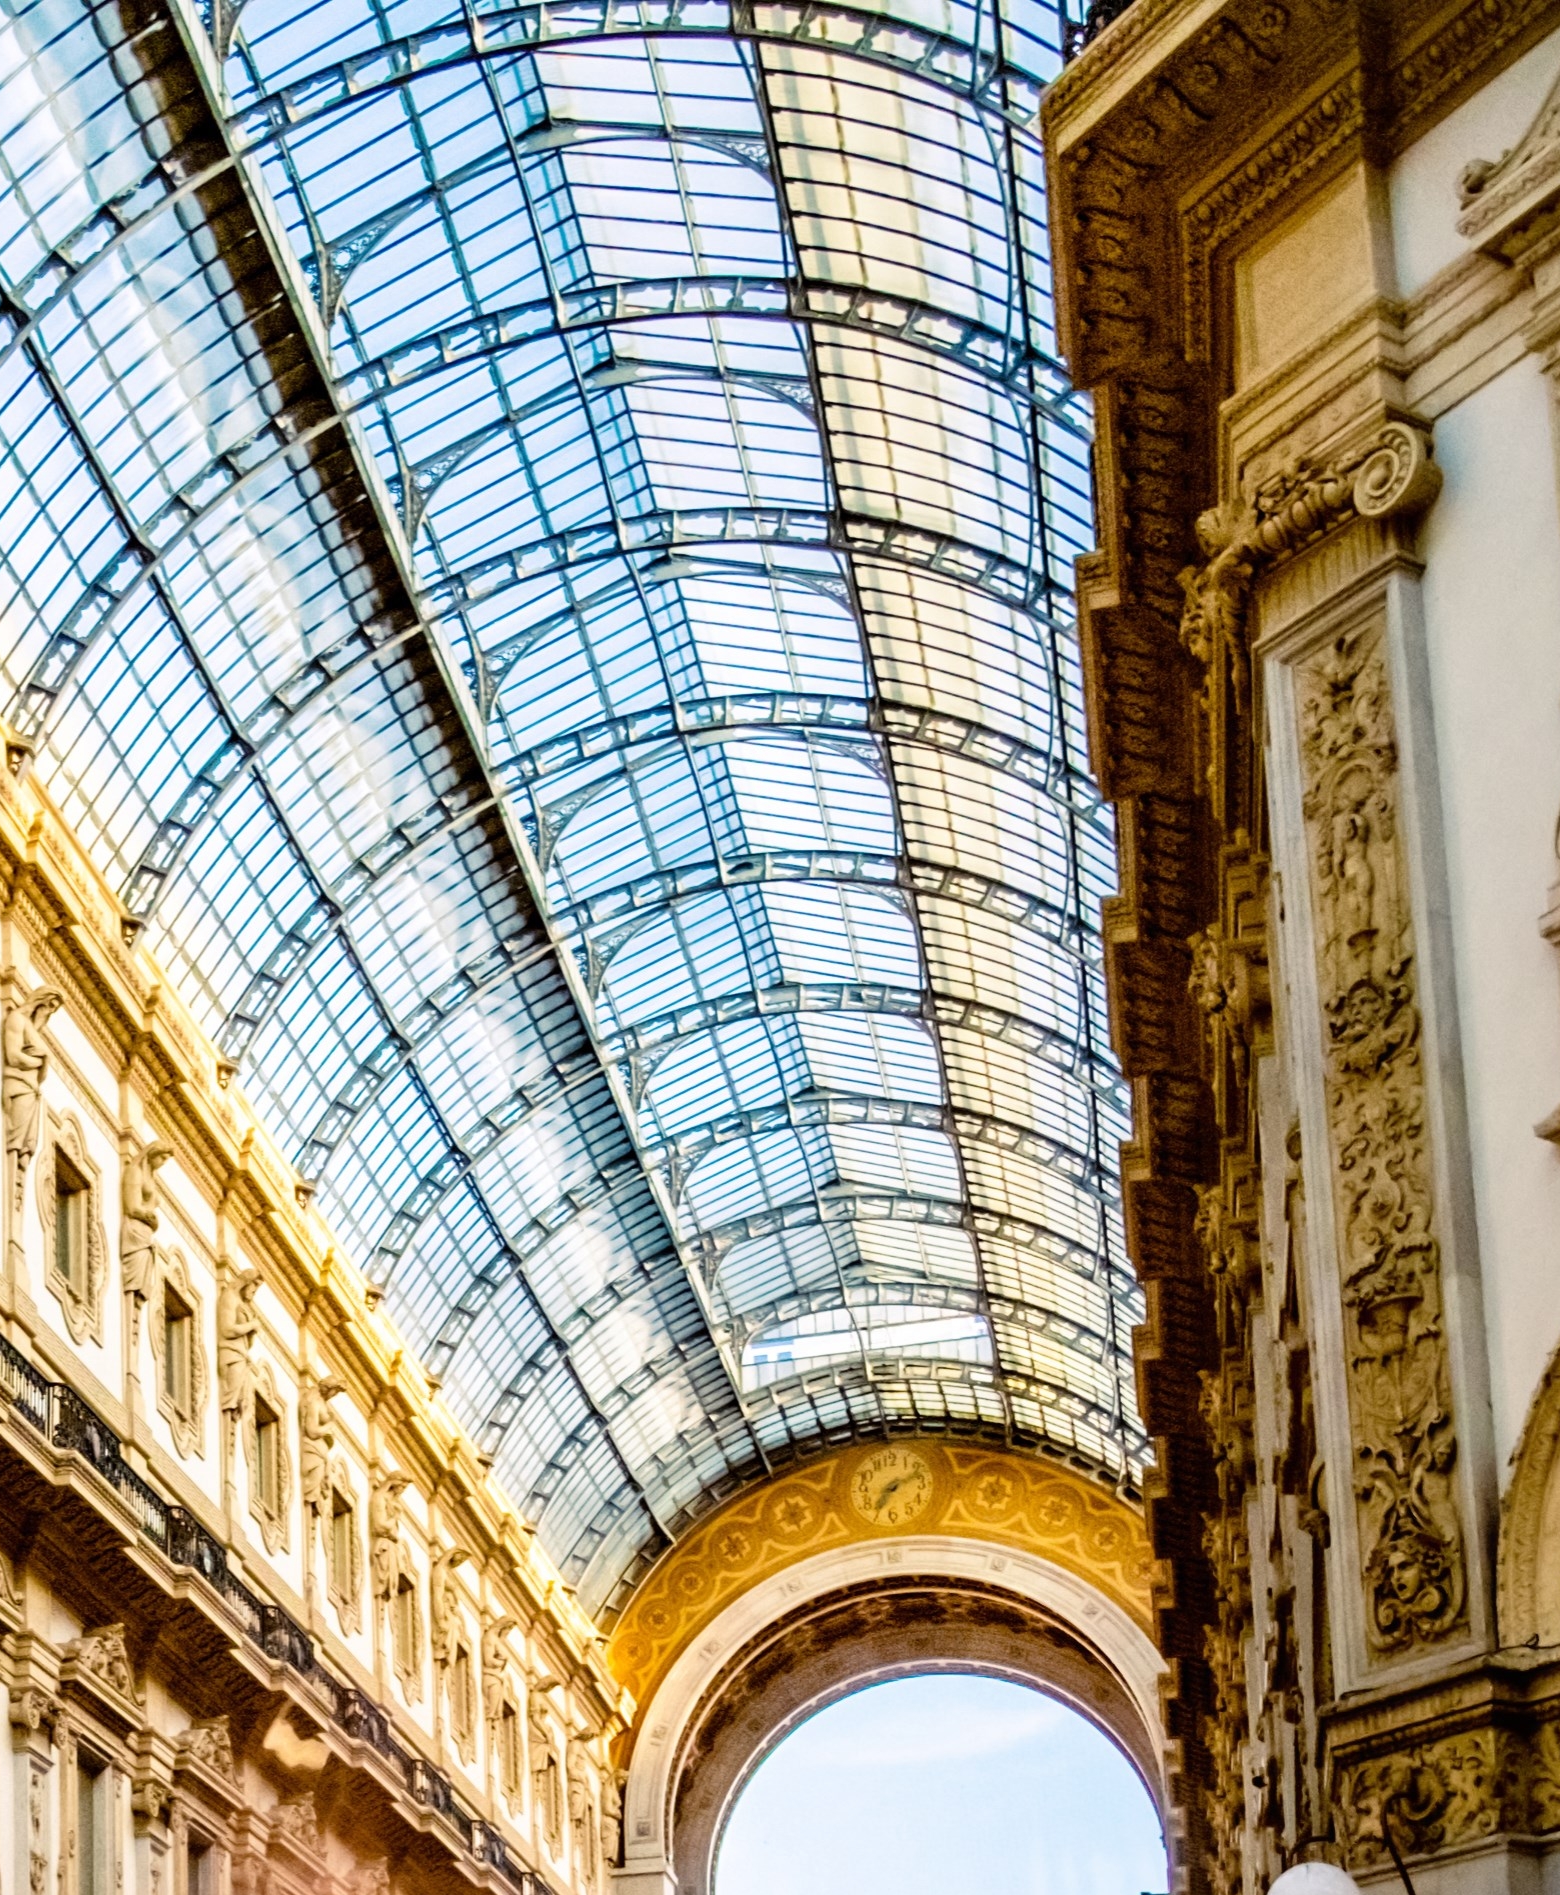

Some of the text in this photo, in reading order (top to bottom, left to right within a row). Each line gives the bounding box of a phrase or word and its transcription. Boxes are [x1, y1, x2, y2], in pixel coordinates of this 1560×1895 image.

[883, 1453, 897, 1467] 12
[903, 1456, 908, 1470] 1
[861, 1470, 873, 1484] 10
[917, 1474, 926, 1490] 3
[888, 1506, 898, 1522] 6
[905, 1502, 914, 1516] 5
